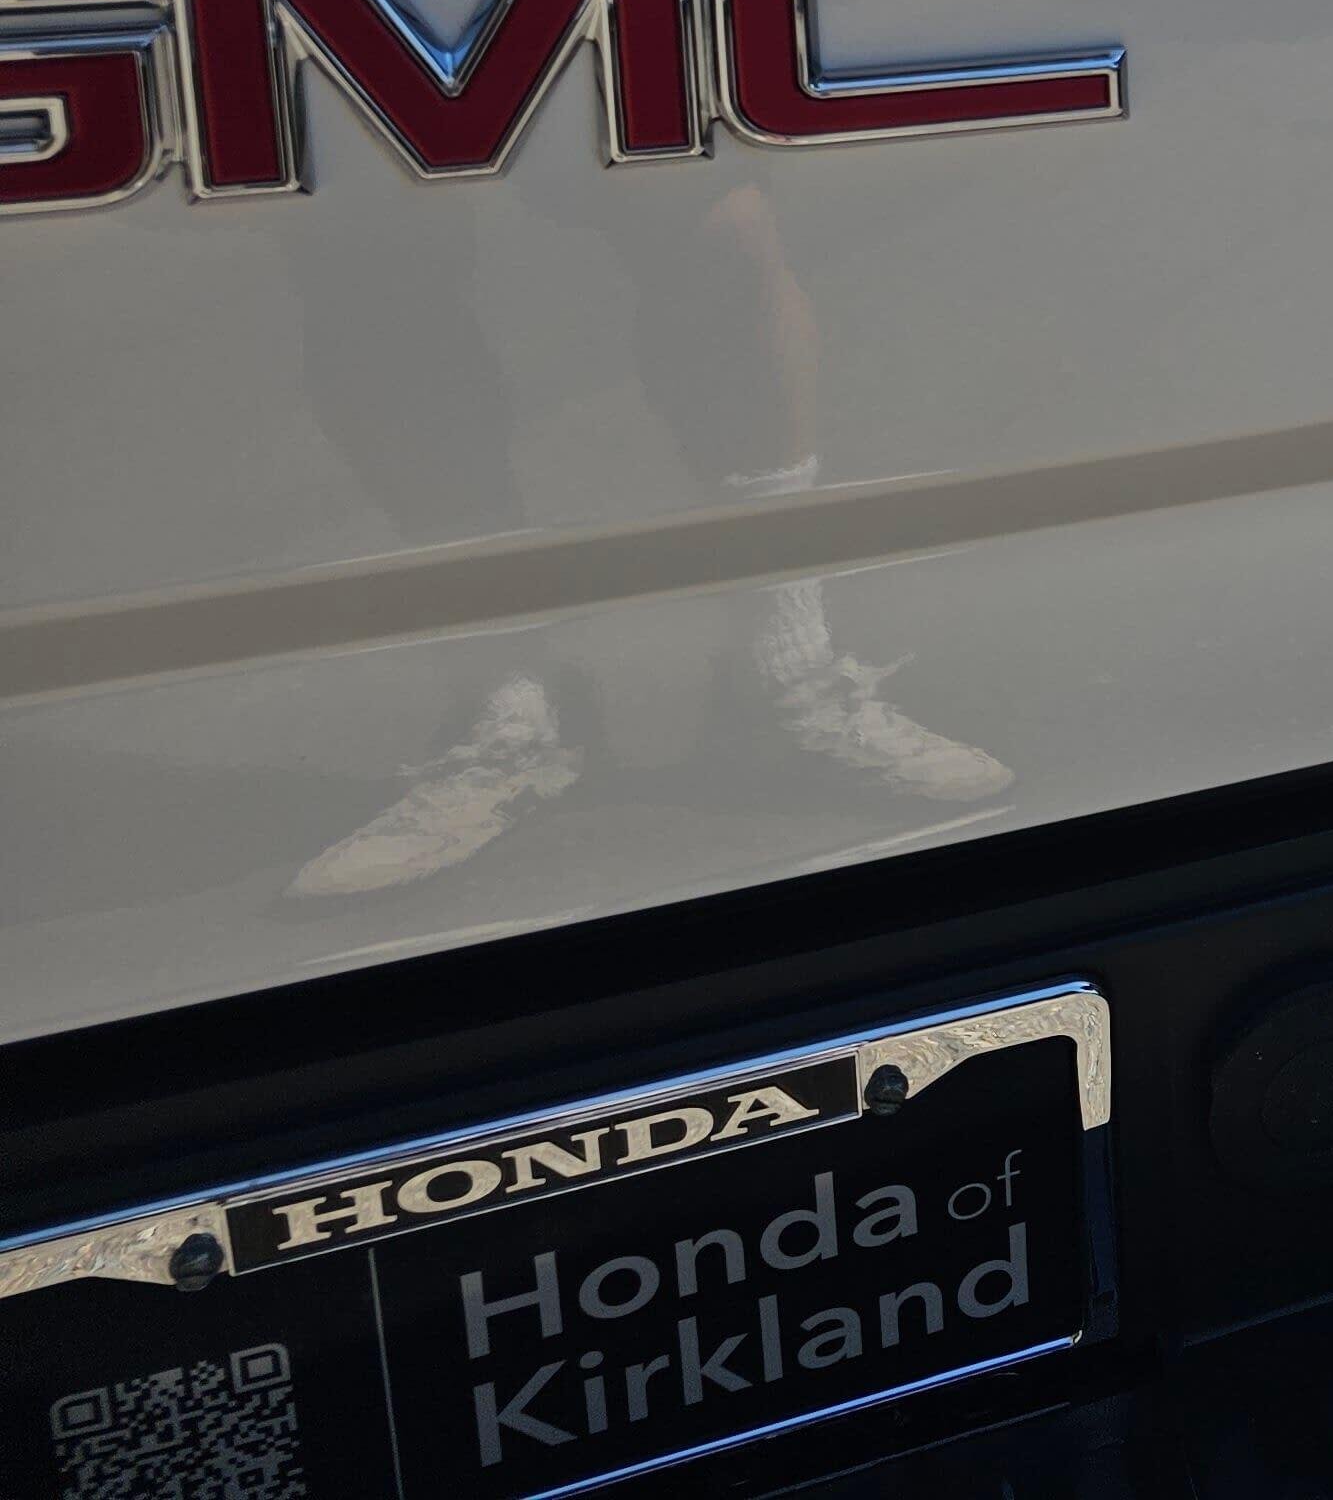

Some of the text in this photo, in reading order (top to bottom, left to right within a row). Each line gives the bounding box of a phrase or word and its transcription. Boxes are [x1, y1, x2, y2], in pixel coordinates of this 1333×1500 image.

[274, 1081, 819, 1251] HONDA
[459, 1148, 1022, 1359] Honda of
[472, 1223, 1031, 1467] Kirkland
